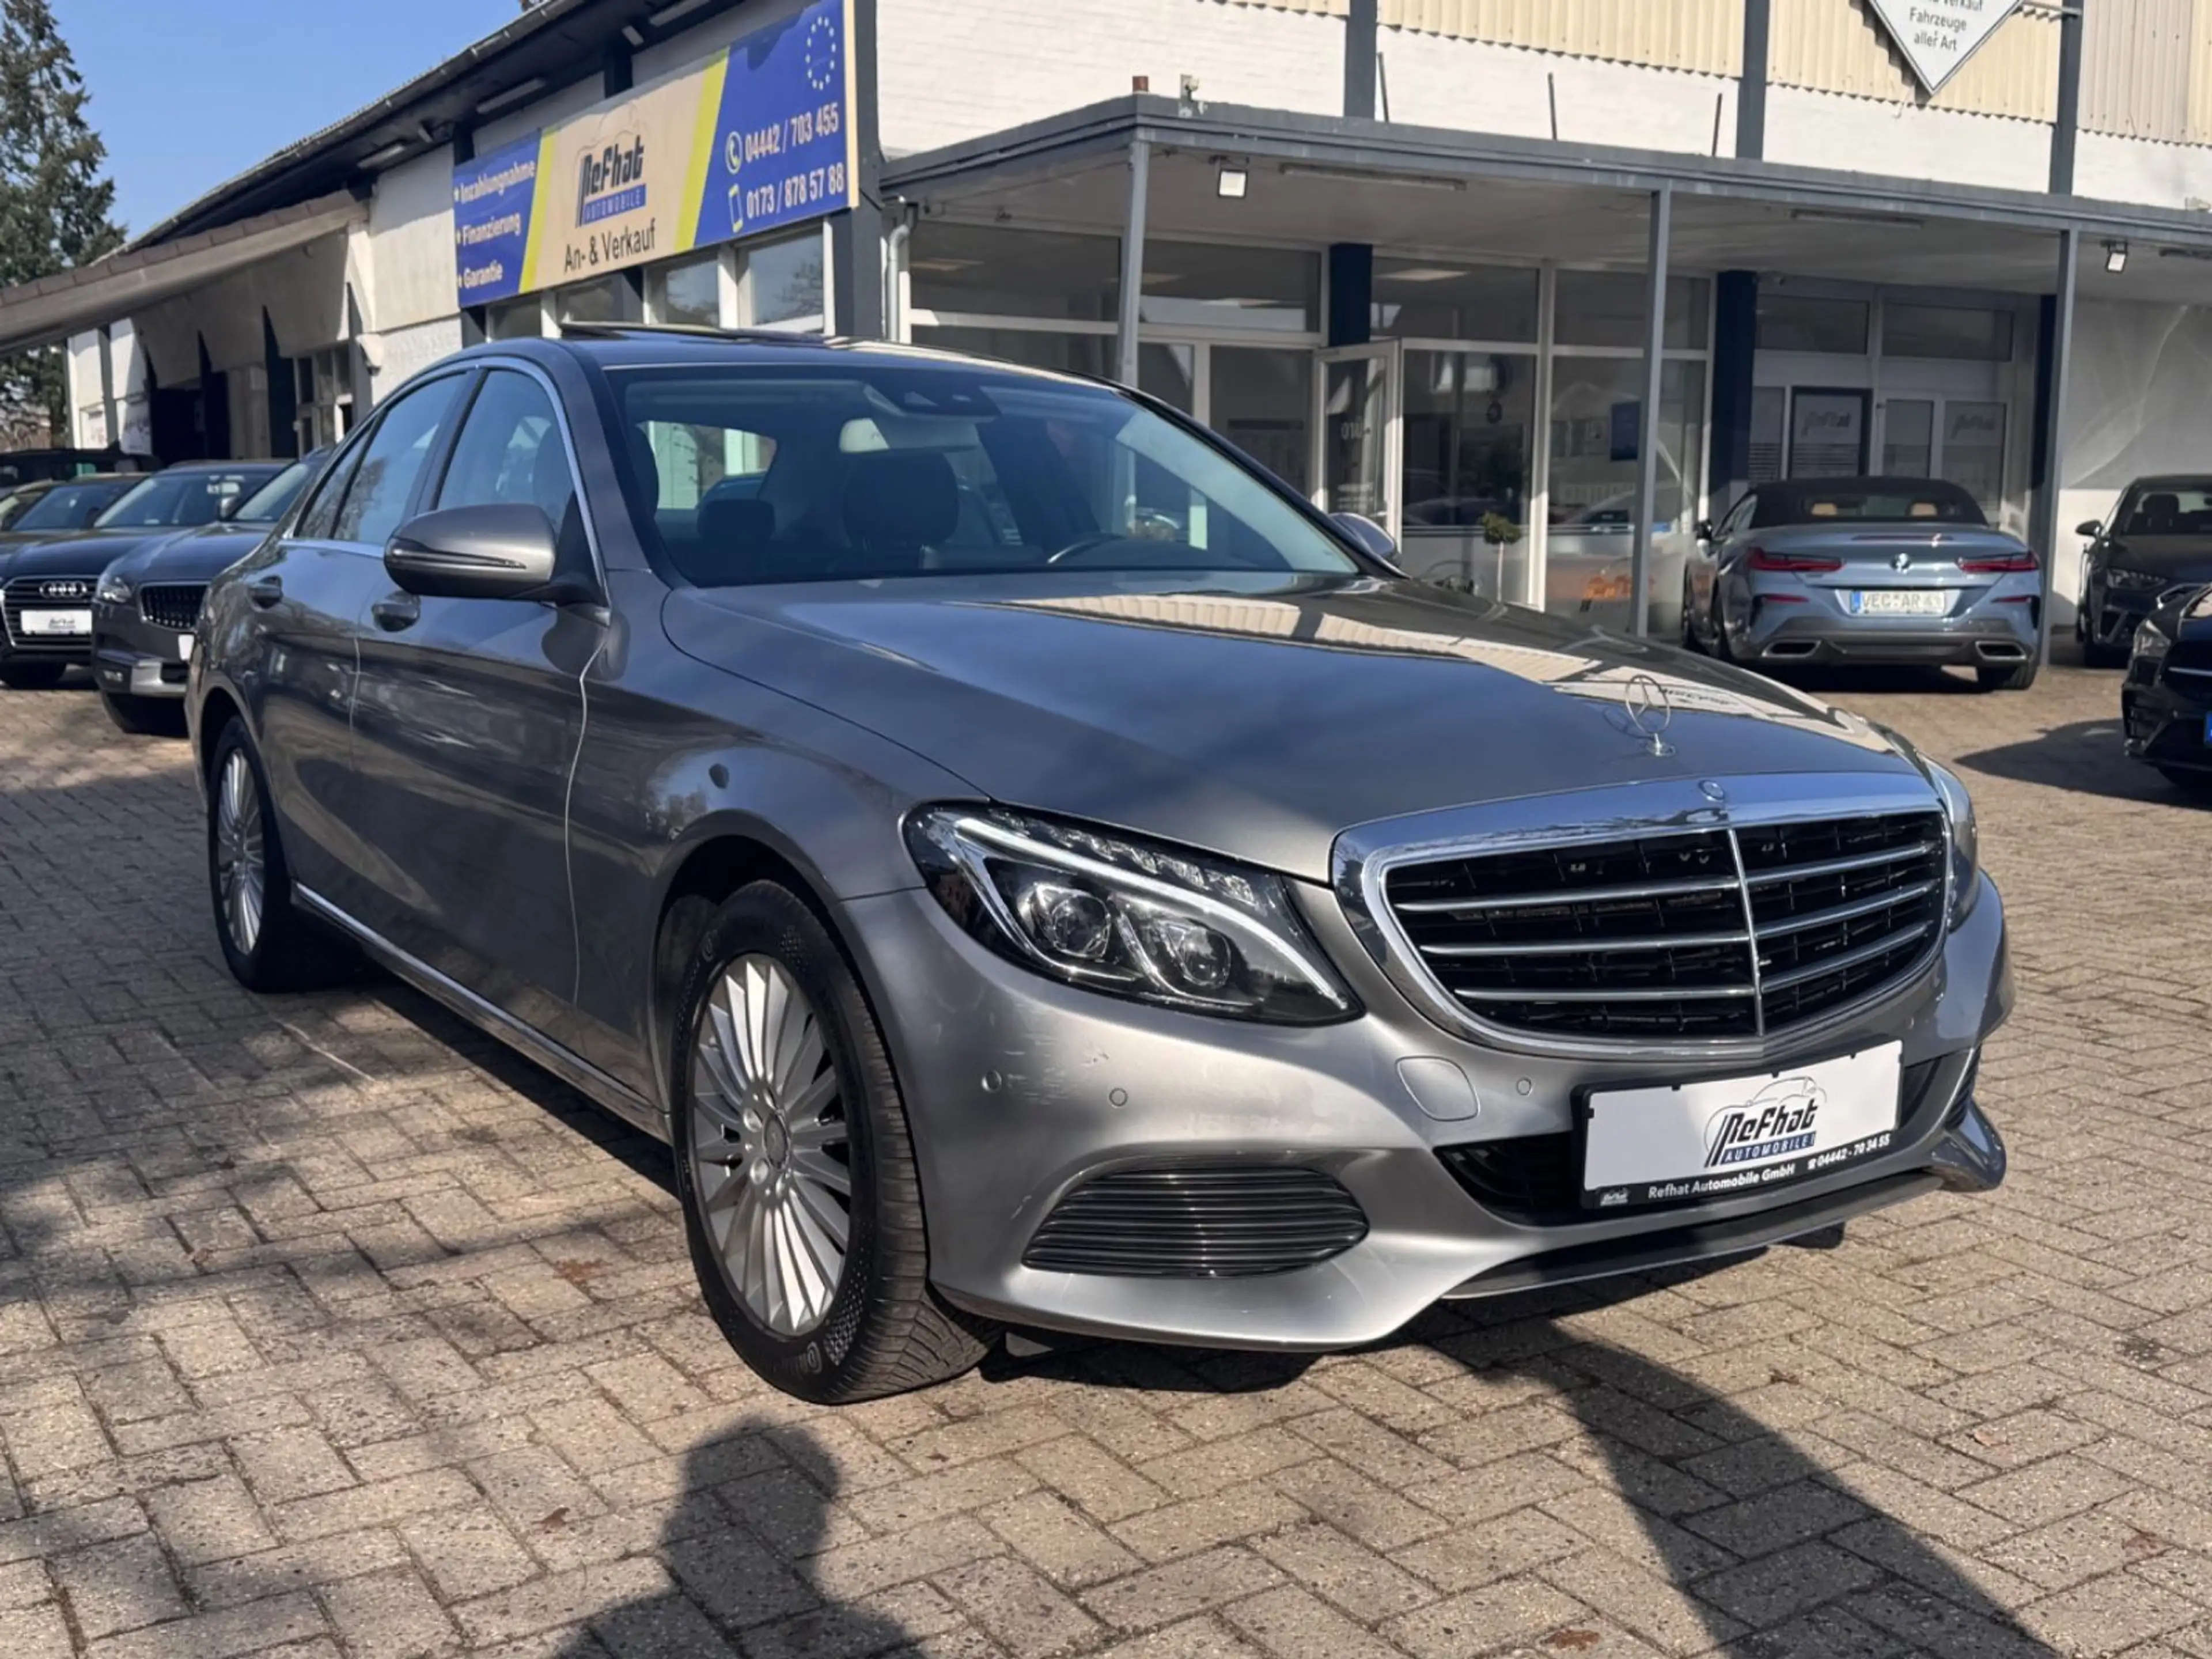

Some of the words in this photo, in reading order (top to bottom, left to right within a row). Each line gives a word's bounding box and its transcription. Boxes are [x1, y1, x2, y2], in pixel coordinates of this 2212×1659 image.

[1910, 6, 1967, 33] Fahrzeuge
[1914, 31, 1938, 47] aller
[1941, 35, 1957, 51] Art
[745, 123, 780, 164] 04442
[782, 119, 788, 154] /
[791, 111, 813, 147] 703
[816, 102, 839, 137] 455
[747, 184, 775, 219] 0173
[777, 181, 783, 214] /
[785, 174, 806, 209] 878
[809, 168, 824, 202] 57
[828, 162, 844, 195] 88
[564, 244, 586, 273] An-
[589, 236, 599, 266] &
[601, 217, 656, 262] Verkauf
[464, 260, 503, 289] Garantie
[1648, 1183, 1689, 1199] Refhat
[1691, 1170, 1760, 1194] Automobile
[1762, 1163, 1796, 1181] GmbH
[1817, 1146, 1847, 1167] 04442
